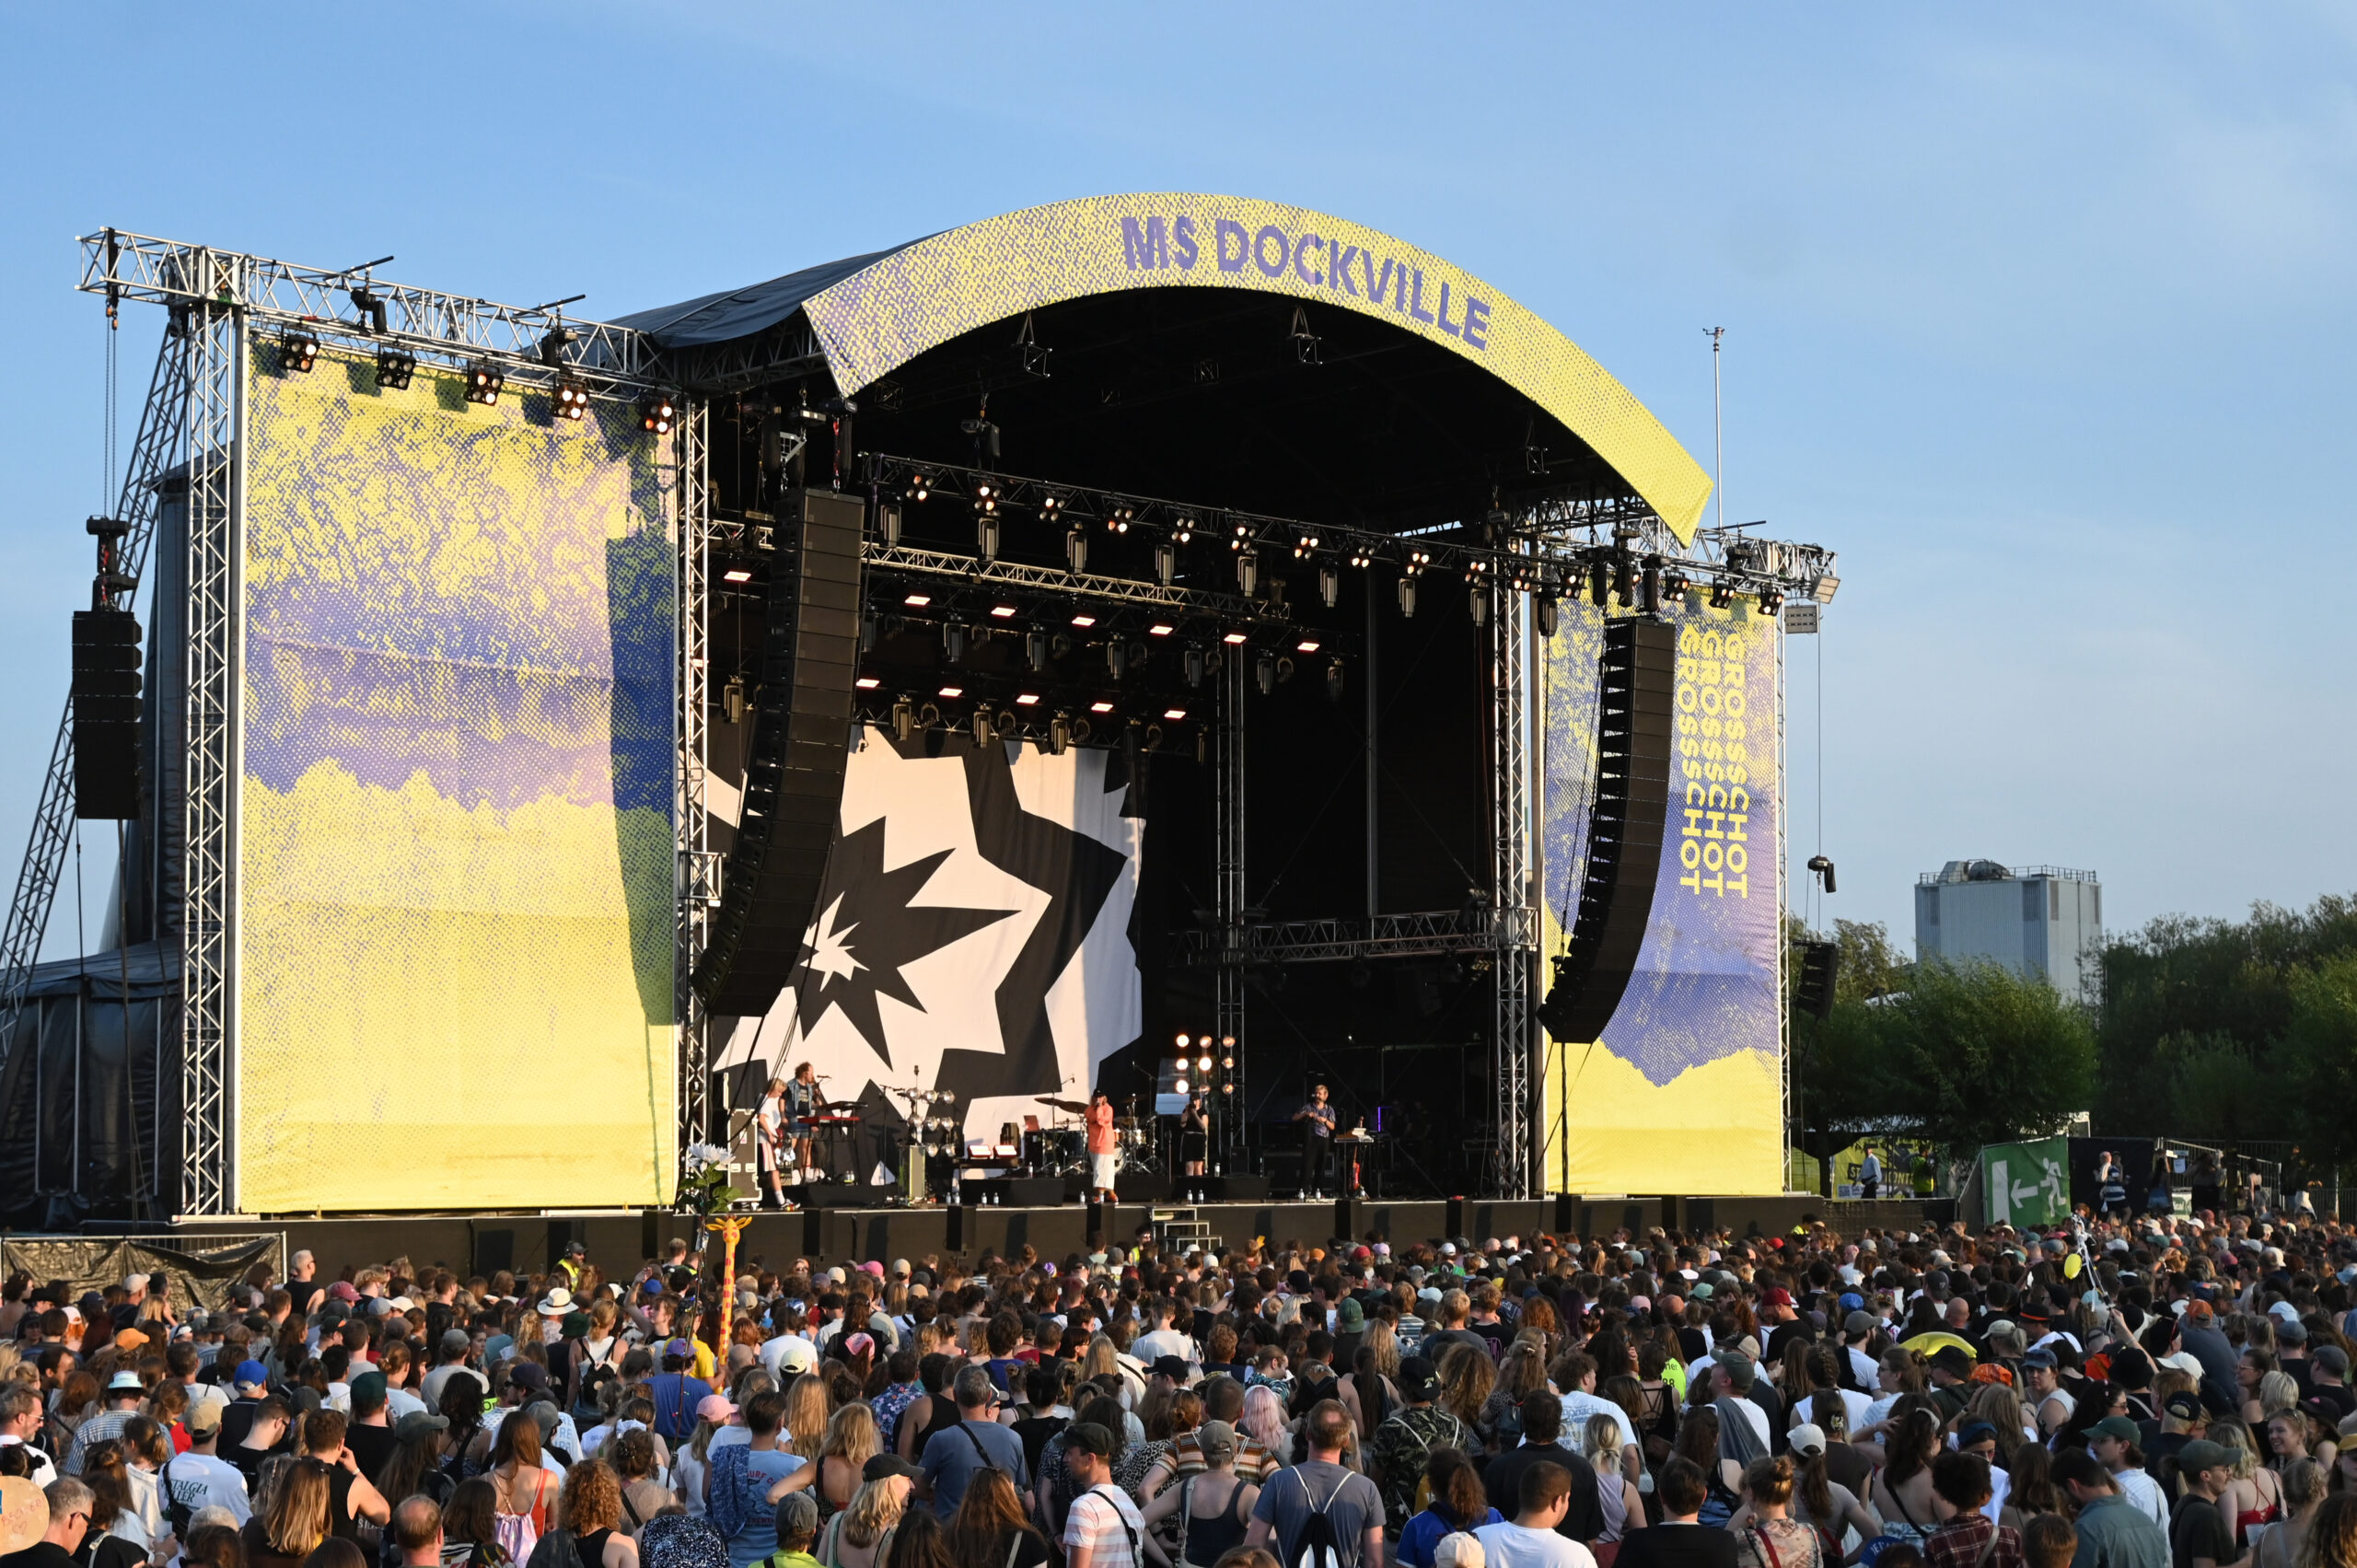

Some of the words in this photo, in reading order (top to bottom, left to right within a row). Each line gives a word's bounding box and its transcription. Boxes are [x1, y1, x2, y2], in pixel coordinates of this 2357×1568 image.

[1120, 215, 1198, 271] MS
[1214, 218, 1492, 352] DOCKVILLE
[1678, 625, 1706, 895] GROSSSCHOT
[1701, 630, 1728, 898] GROSSSCHOT
[1724, 633, 1750, 899] GROSSSCHOT
